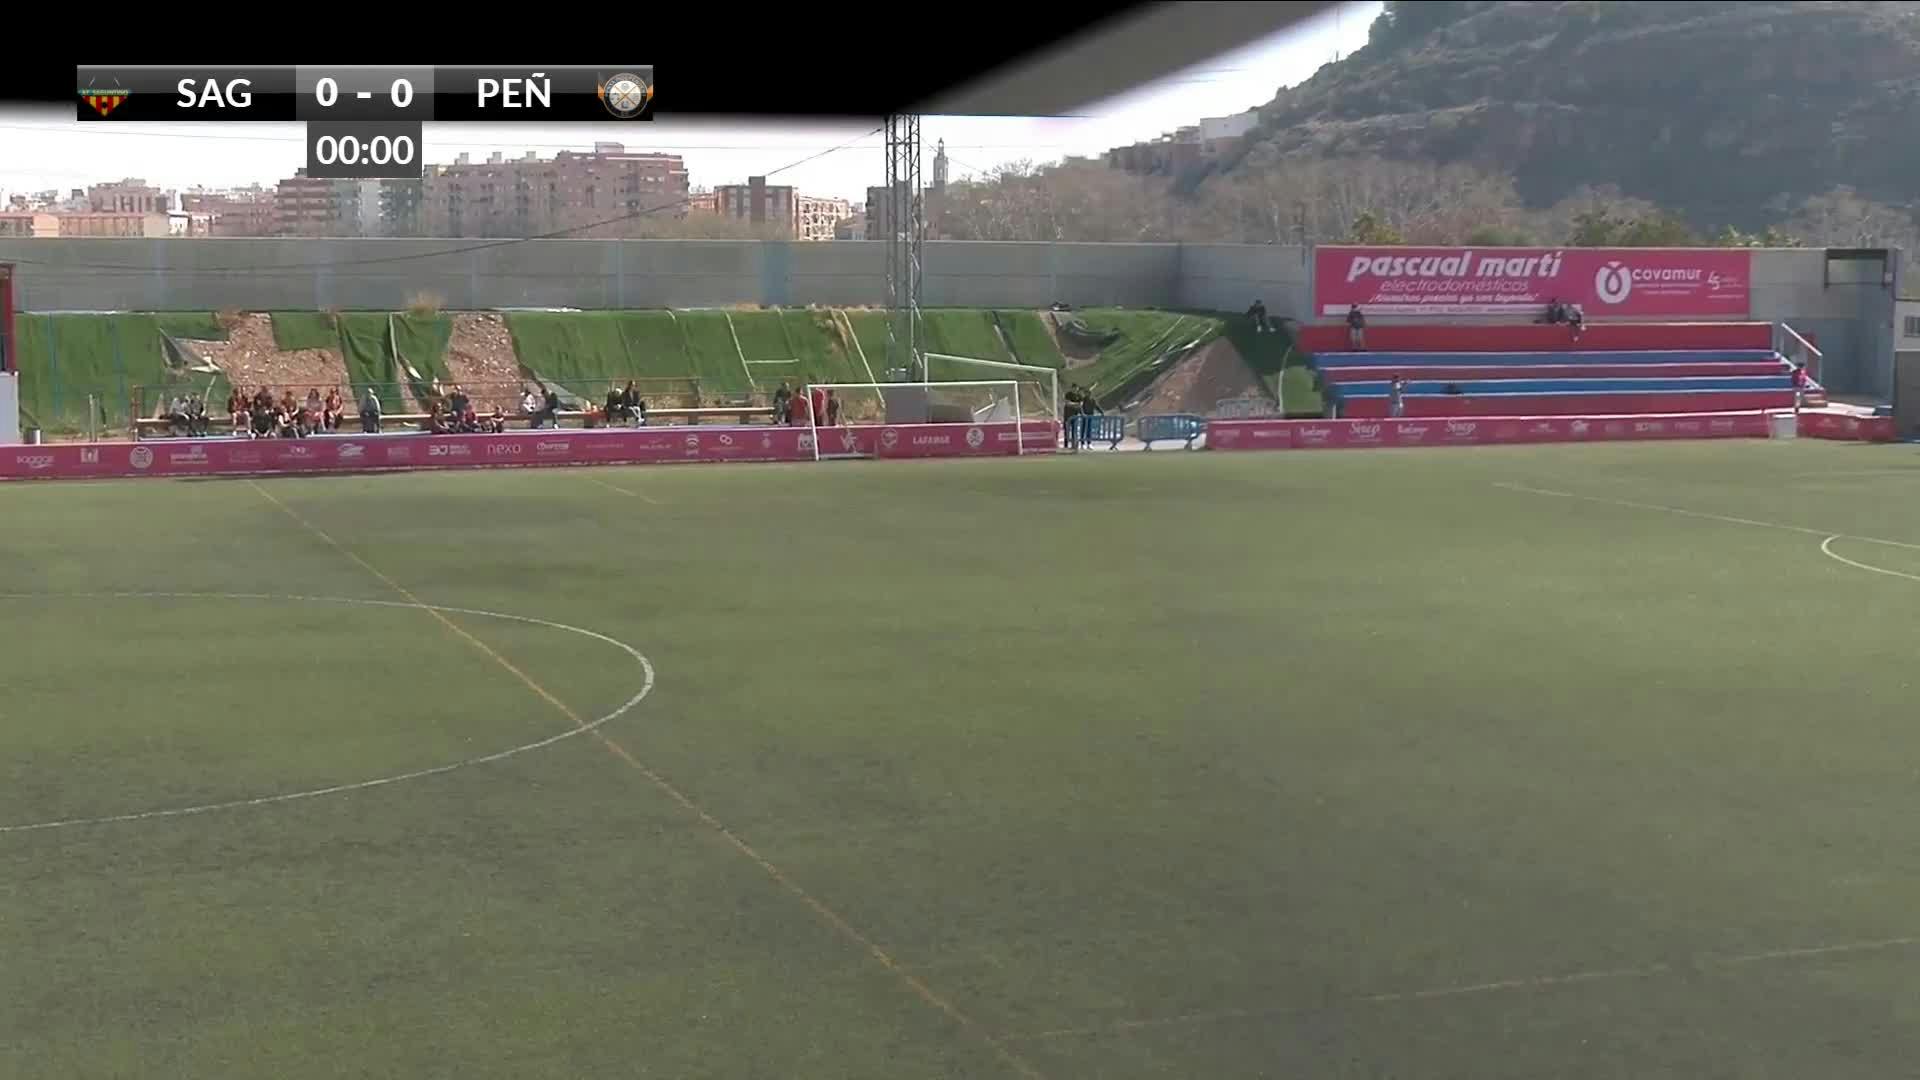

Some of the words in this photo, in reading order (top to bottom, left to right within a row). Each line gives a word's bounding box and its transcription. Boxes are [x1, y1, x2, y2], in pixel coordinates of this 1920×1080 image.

[1347, 251, 1473, 282] pascual
[1631, 268, 1704, 281] covamur
[487, 443, 522, 456] nexo
